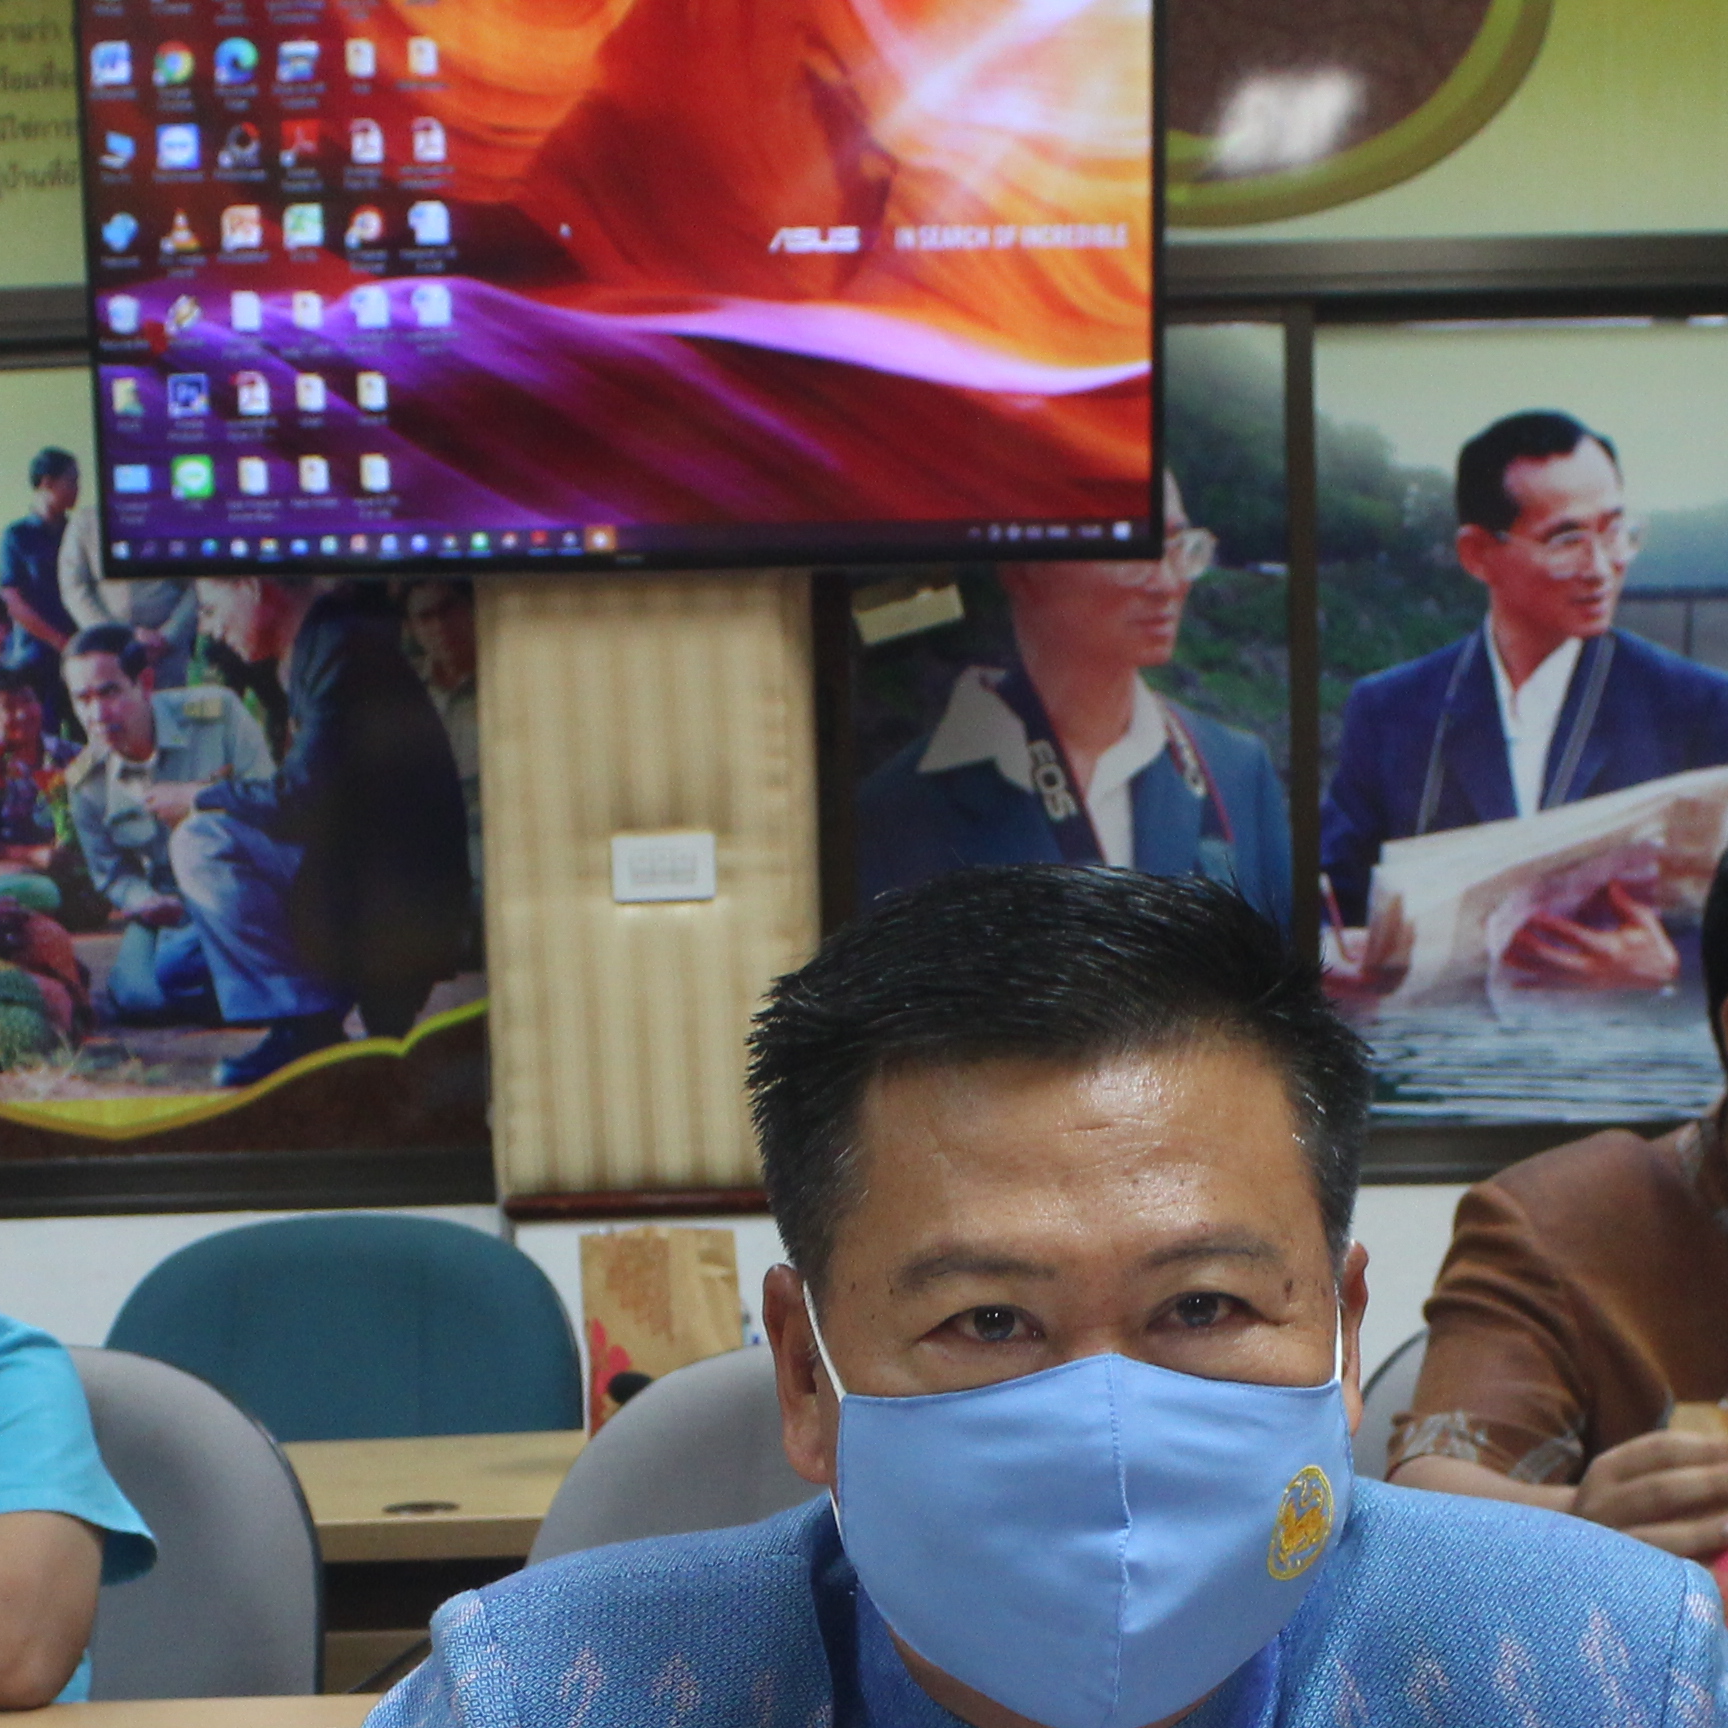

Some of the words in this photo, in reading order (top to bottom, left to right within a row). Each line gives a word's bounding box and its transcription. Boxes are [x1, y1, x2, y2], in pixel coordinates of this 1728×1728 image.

[769, 226, 860, 254] ASUS
[917, 226, 990, 249] SEARCH
[1020, 223, 1128, 248] INCREDIBLE
[1028, 739, 1078, 823] EOS
